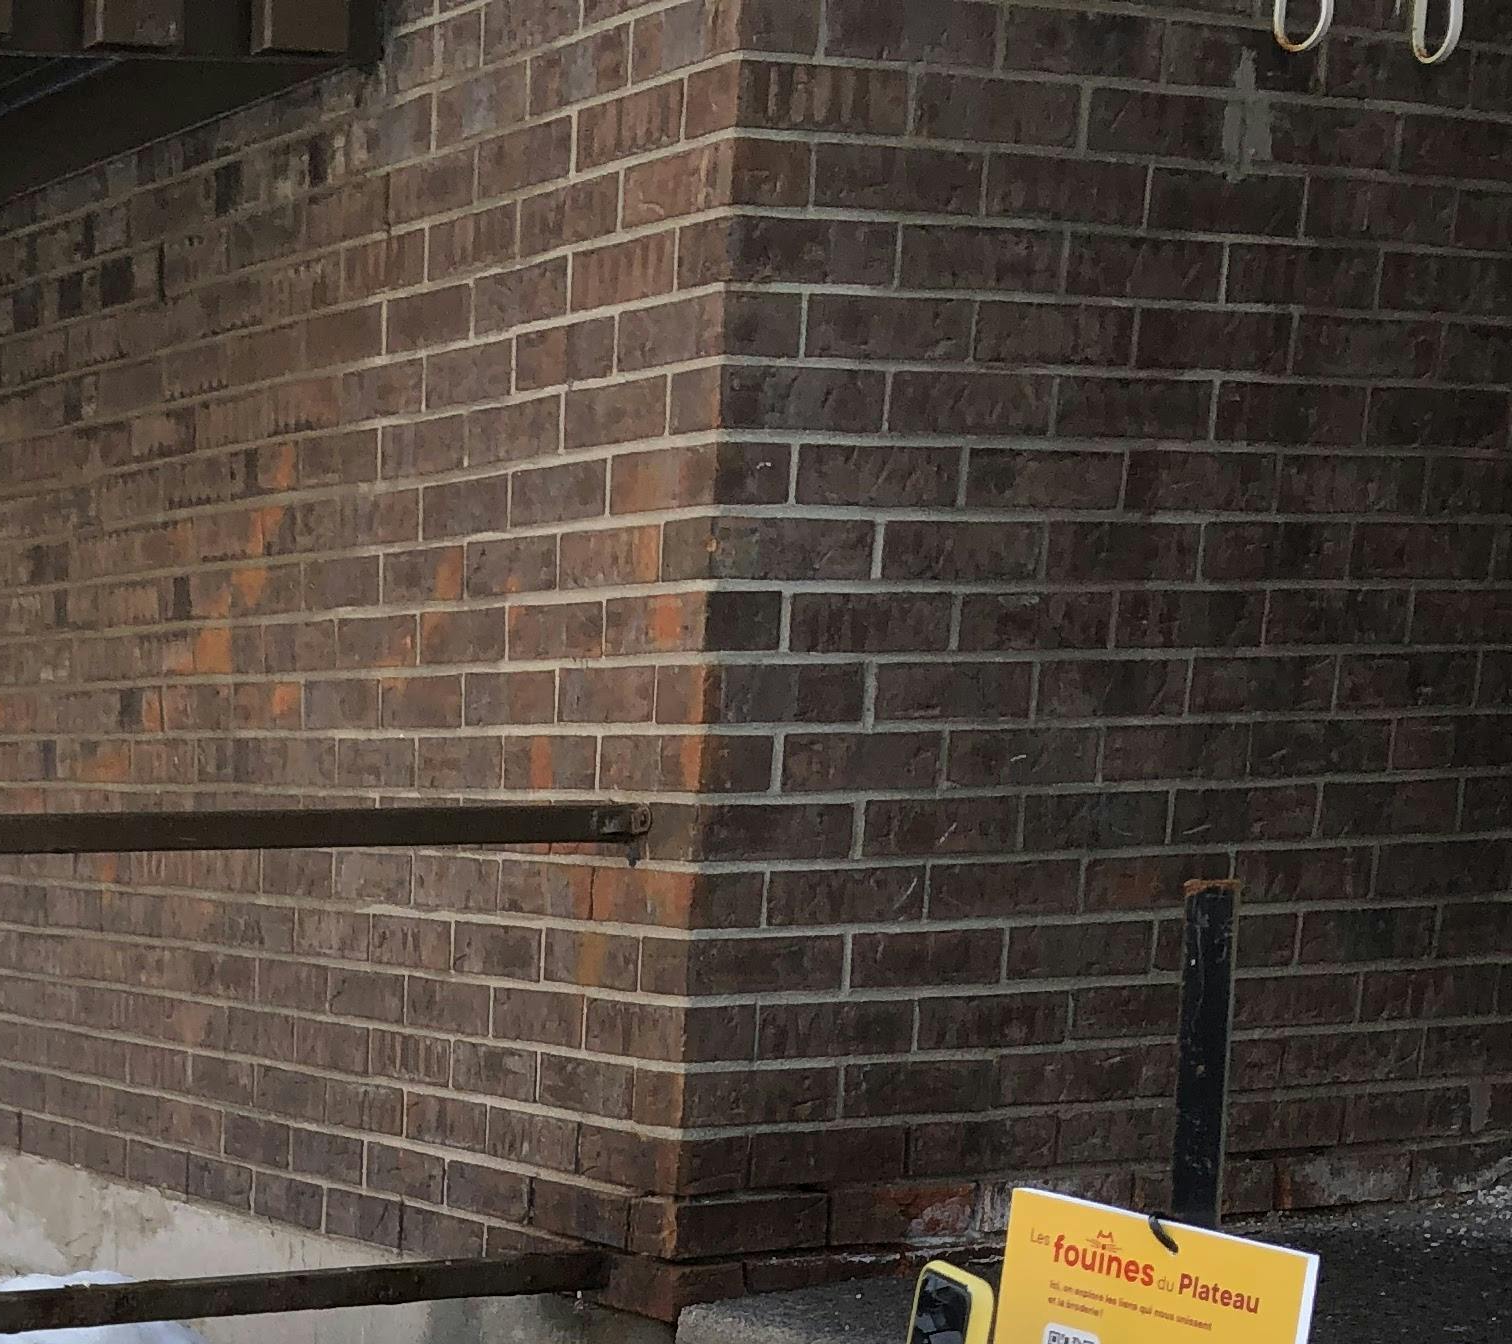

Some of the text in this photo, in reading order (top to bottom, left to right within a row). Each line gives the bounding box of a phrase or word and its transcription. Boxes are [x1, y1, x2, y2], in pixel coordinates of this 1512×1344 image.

[1030, 1227, 1260, 1314] Les fouines du Plateau
[1105, 1294, 1117, 1306] les
[1139, 1304, 1153, 1316] qui
